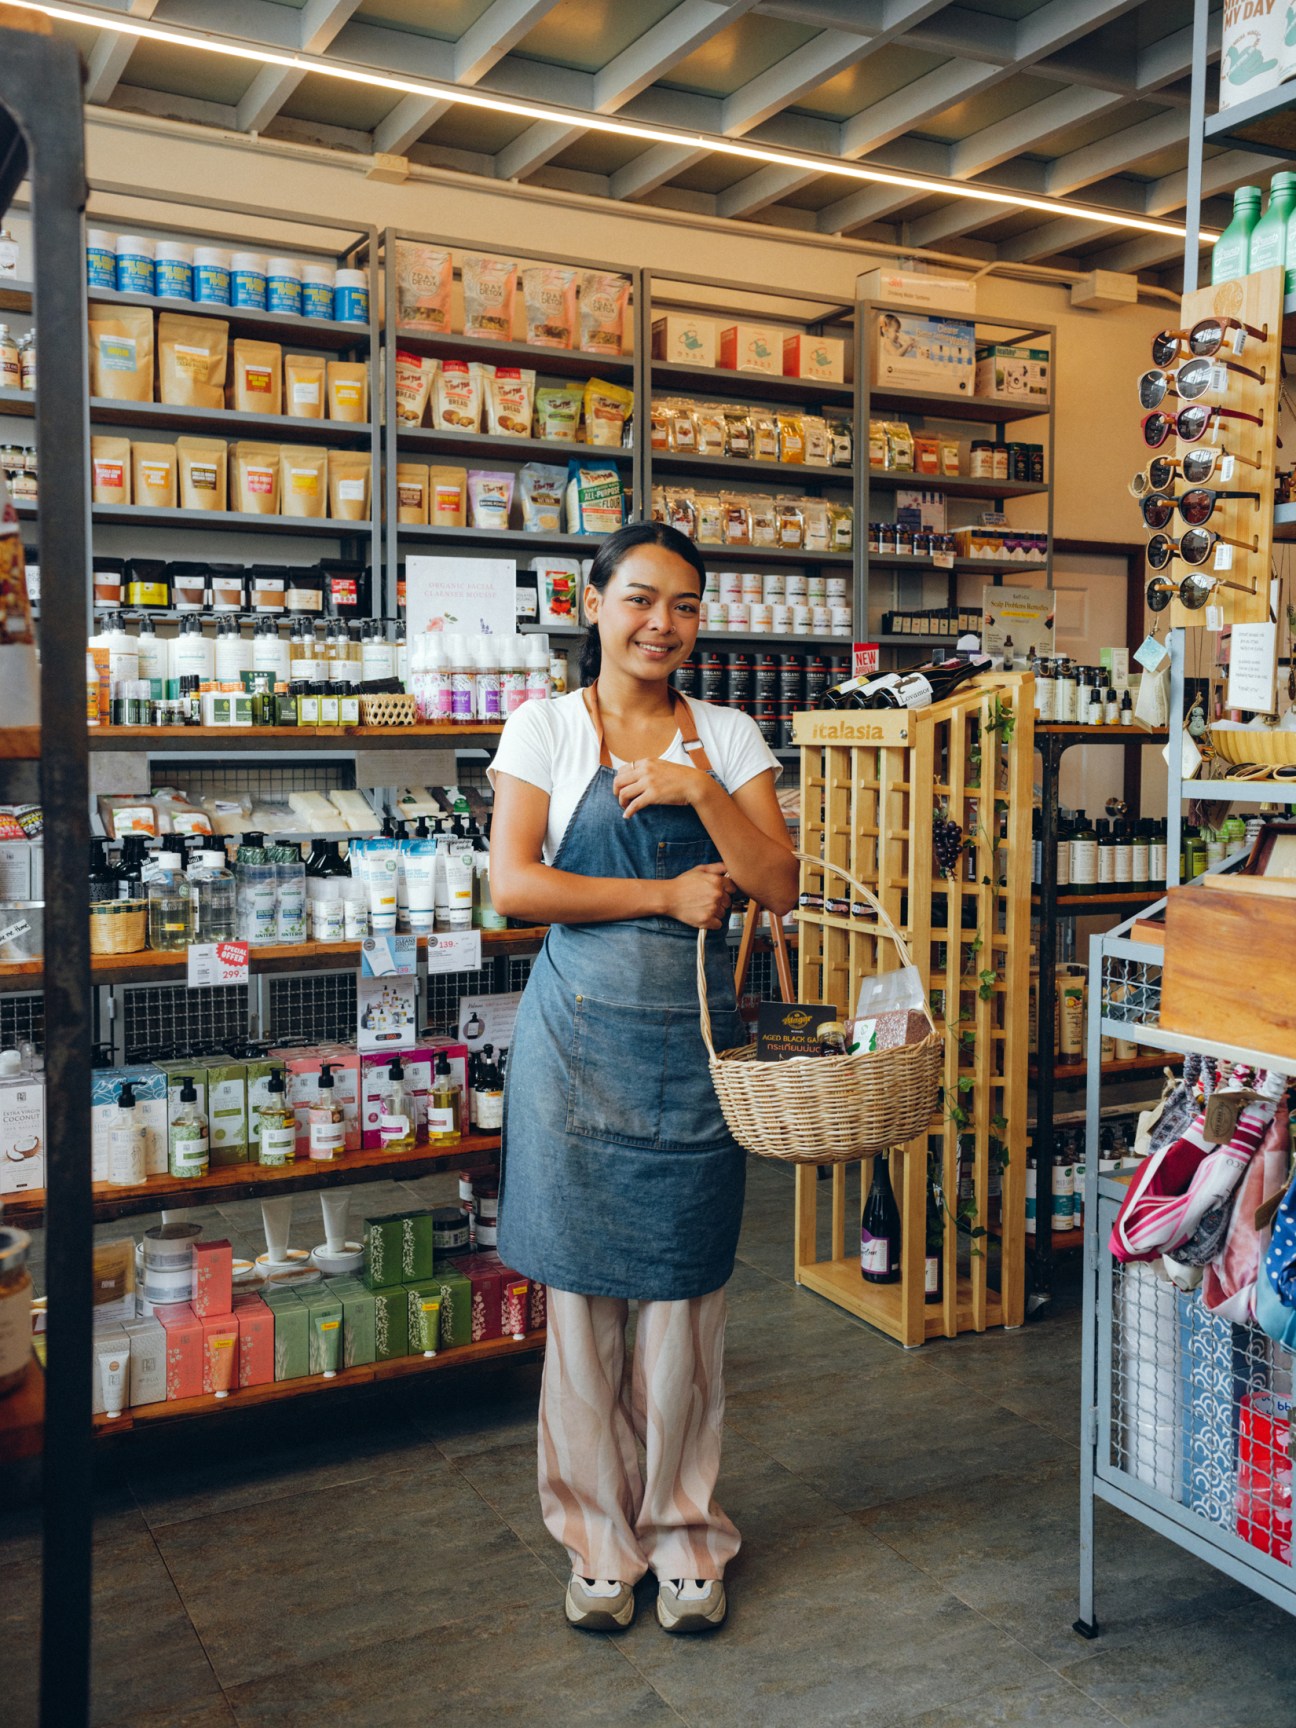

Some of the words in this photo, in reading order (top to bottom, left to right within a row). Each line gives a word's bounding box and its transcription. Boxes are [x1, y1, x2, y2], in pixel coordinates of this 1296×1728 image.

[1243, 0, 1275, 20] DAY
[412, 279, 438, 288] DETOX
[479, 289, 502, 298] DETOX
[541, 298, 563, 307] DETOX
[593, 304, 615, 314] DETOX
[448, 398, 468, 408] BREAD
[502, 404, 521, 413] BREAD
[584, 487, 620, 500] ALL-PURPOSE
[602, 496, 620, 508] FLOUR
[856, 651, 876, 666] NEW
[899, 687, 930, 704] Lovamor
[812, 720, 884, 740] italasia
[224, 944, 247, 956] SPECIAL
[221, 951, 245, 963] OFFER
[223, 970, 247, 979] 299.-
[3, 1113, 40, 1123] COCONUT
